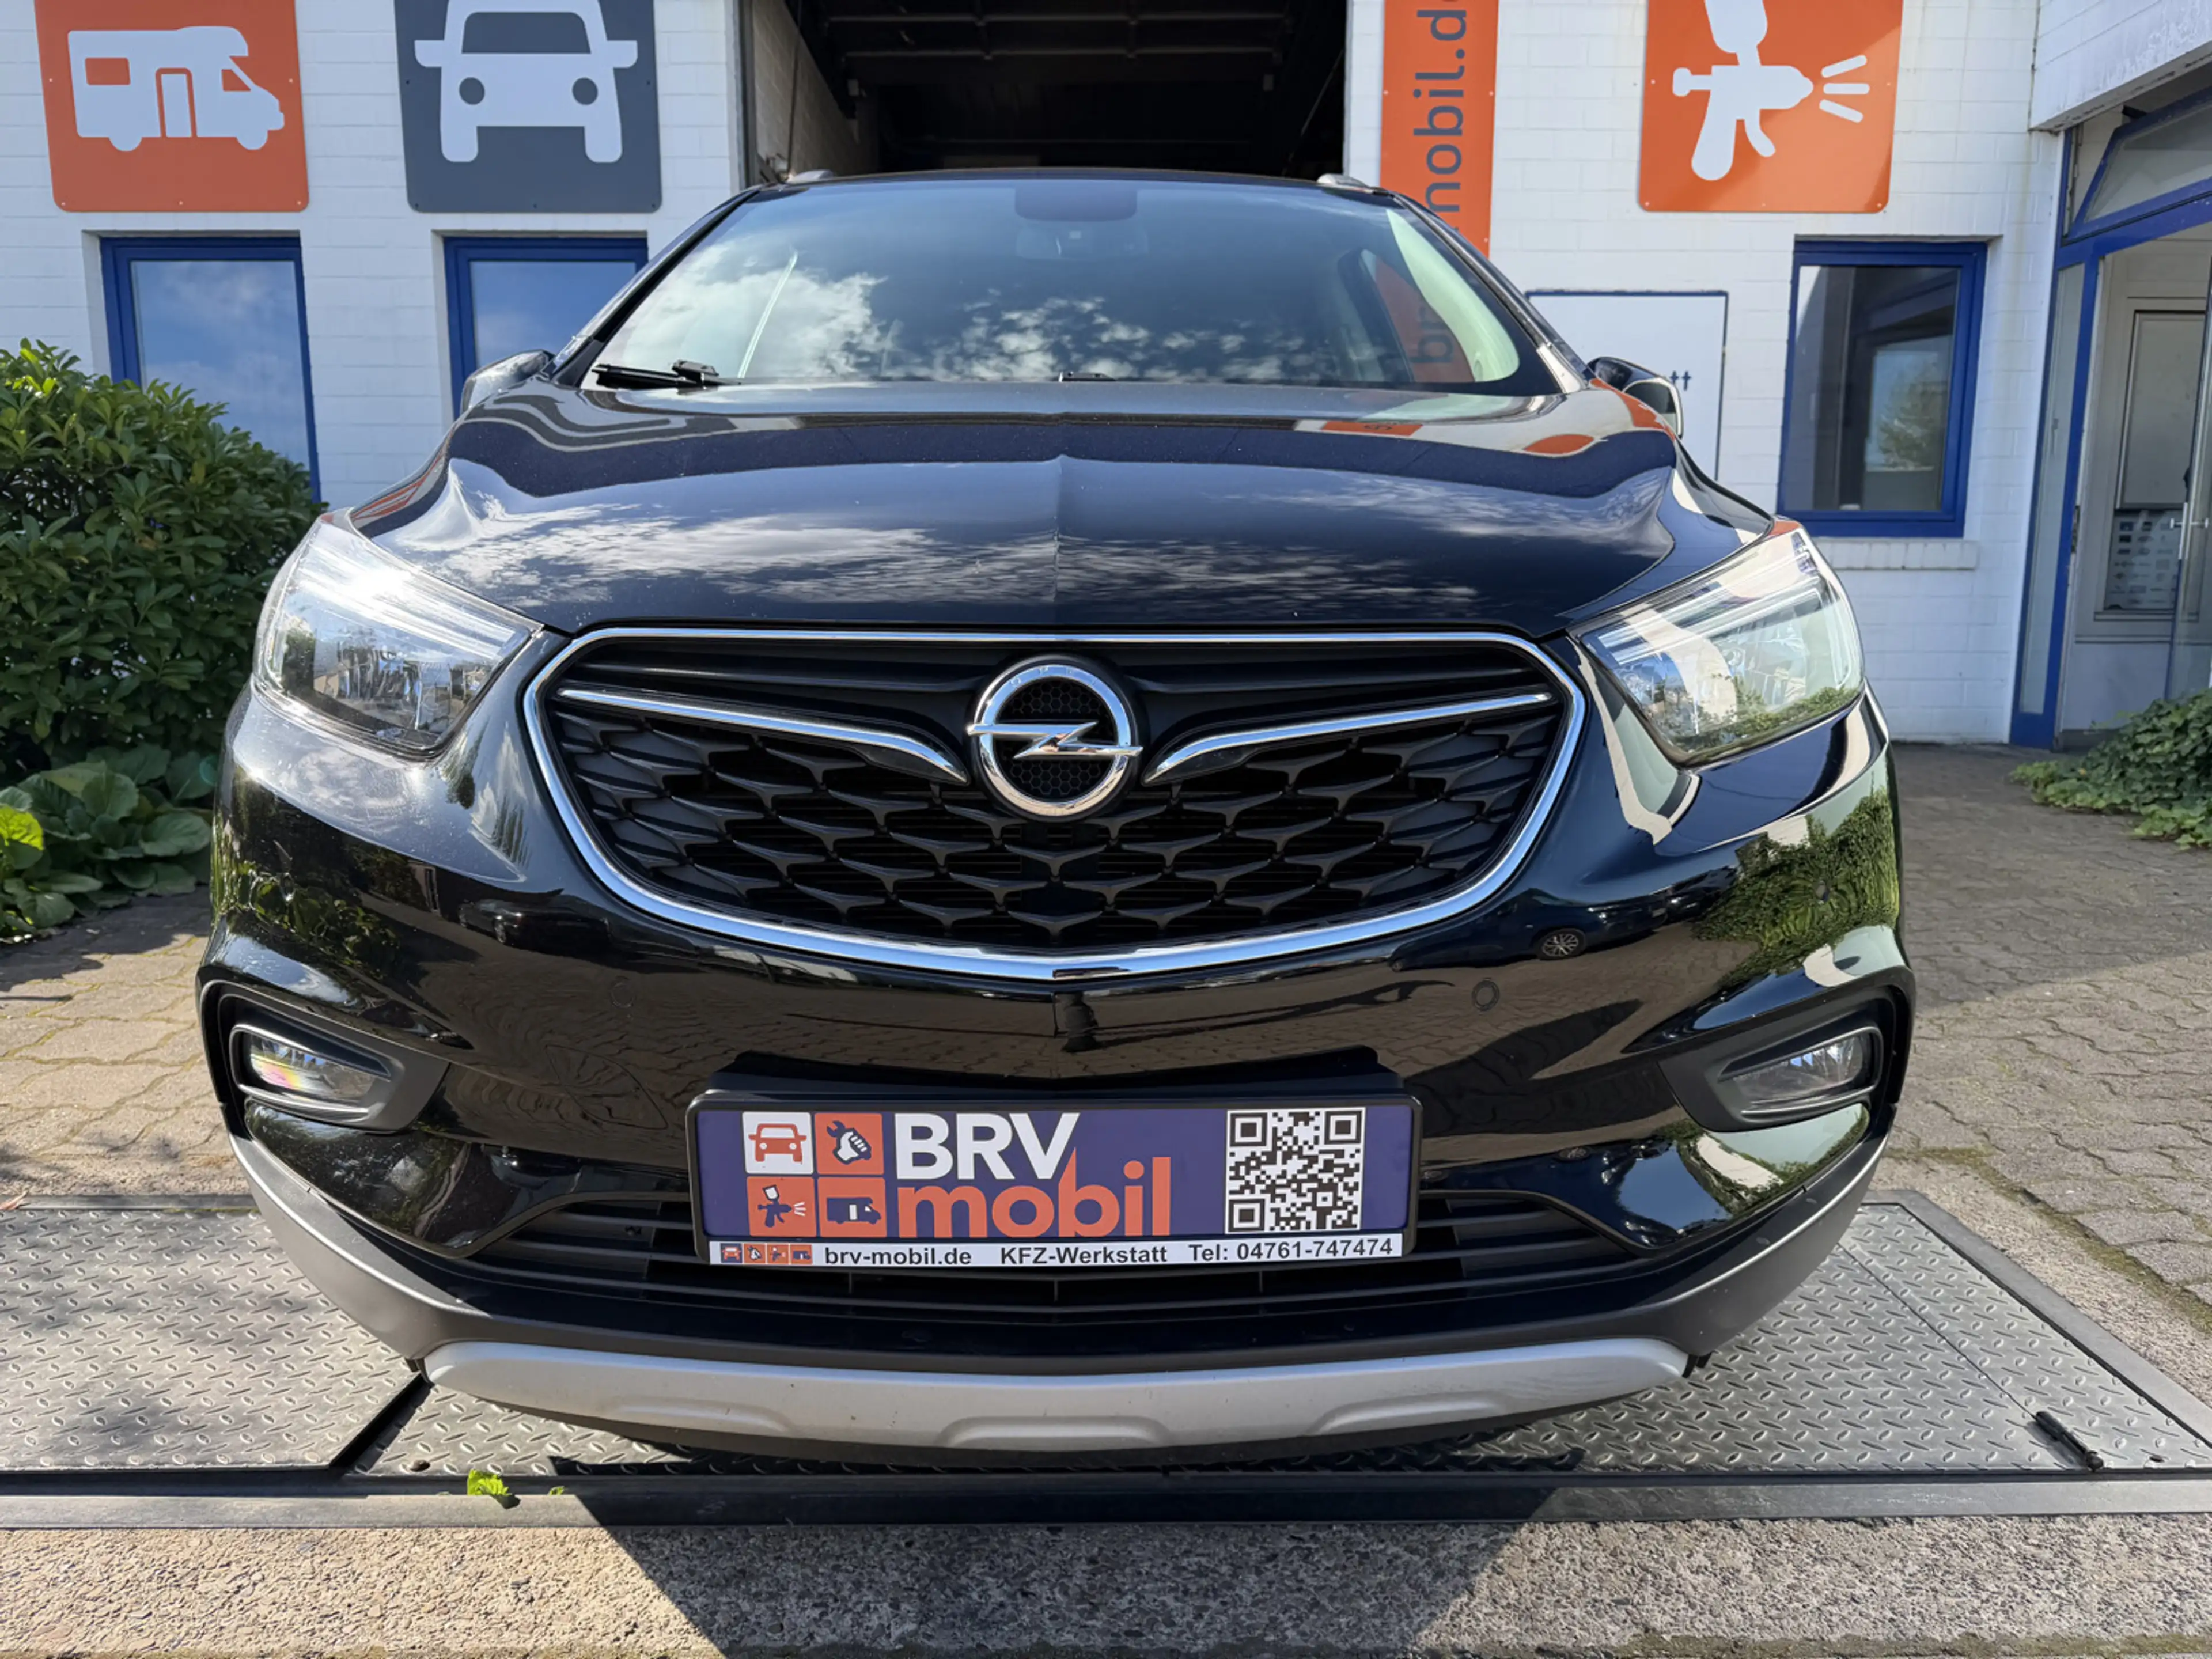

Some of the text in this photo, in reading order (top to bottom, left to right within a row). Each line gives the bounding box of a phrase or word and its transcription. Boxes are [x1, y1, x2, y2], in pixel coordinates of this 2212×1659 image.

[894, 1112, 1081, 1180] BRV
[897, 1147, 1171, 1238] mobil
[825, 1238, 1393, 1266] brv-mobil.de KFZ-Werkstatt Tel: 04761-747474
